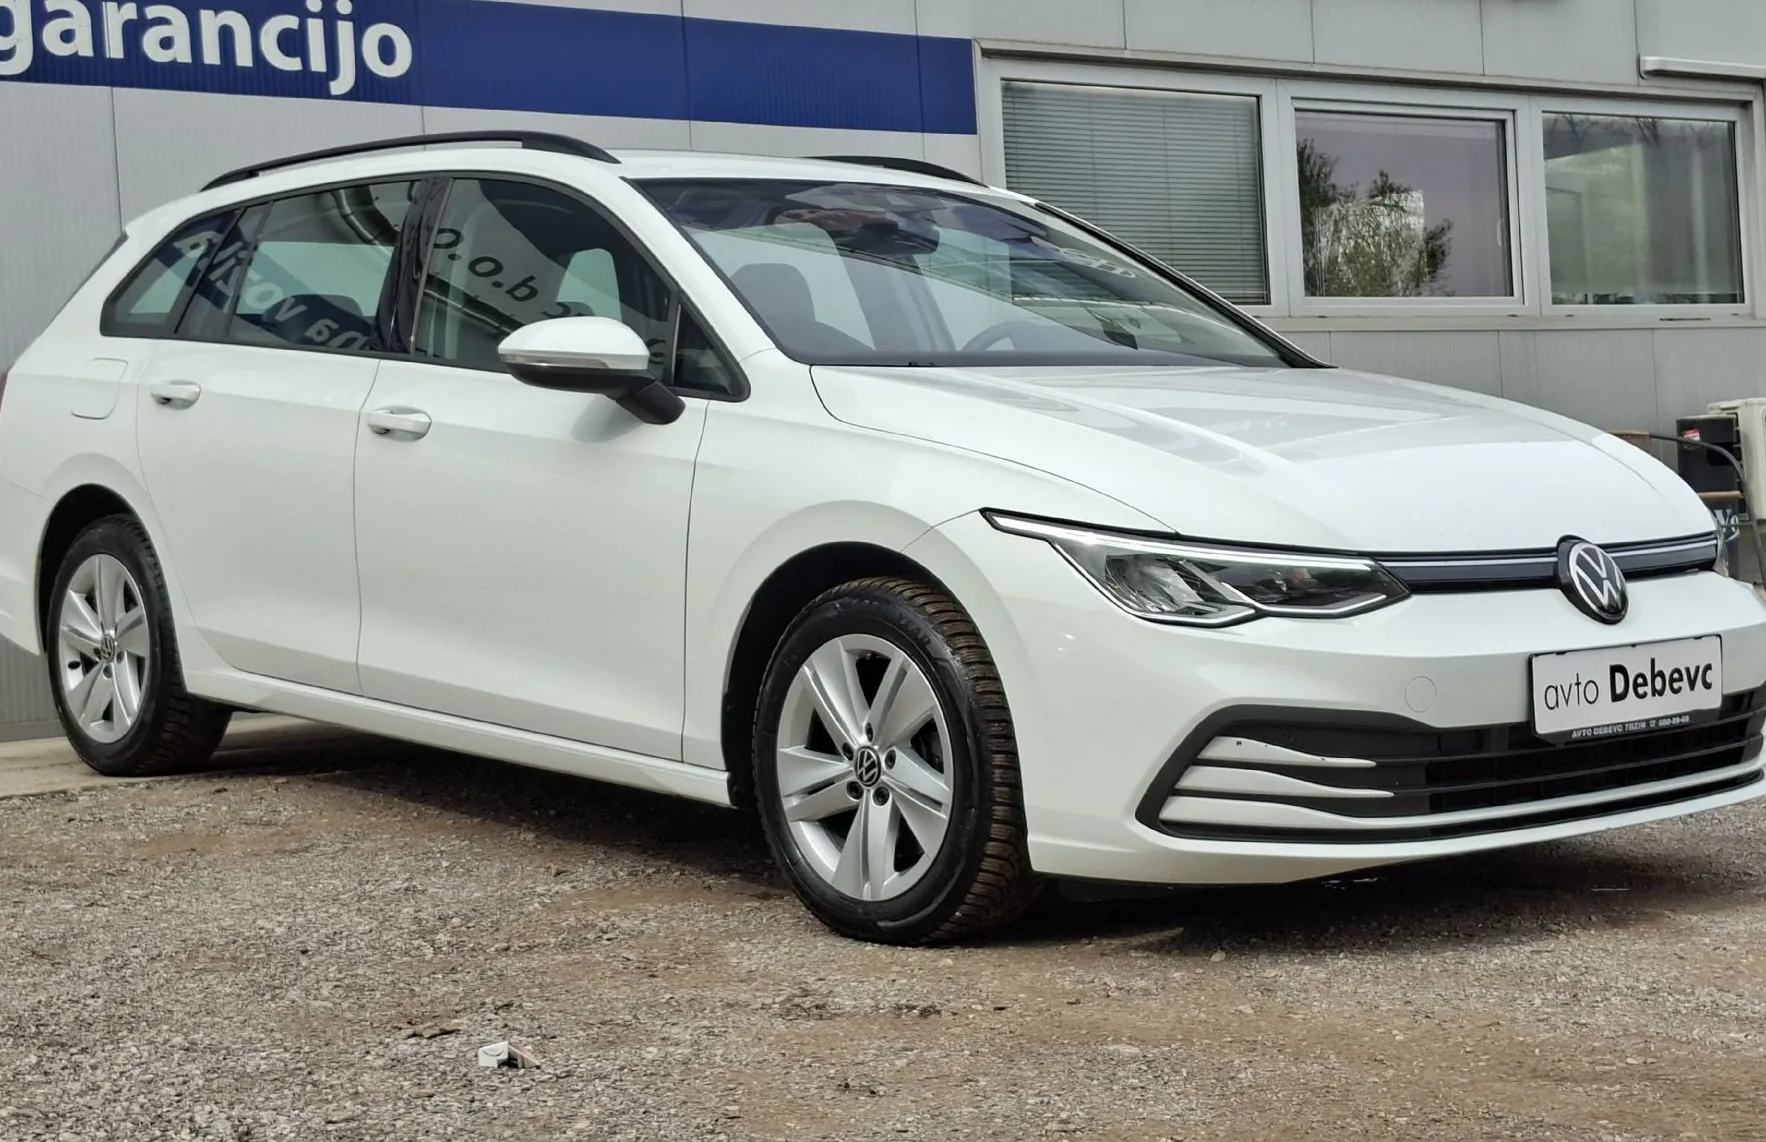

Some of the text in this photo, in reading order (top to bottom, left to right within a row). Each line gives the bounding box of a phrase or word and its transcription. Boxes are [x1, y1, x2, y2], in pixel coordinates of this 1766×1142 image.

[0, 0, 412, 95] garancijo
[1544, 657, 1712, 710] avto Debevc
[1571, 729, 1592, 738] AVTO
